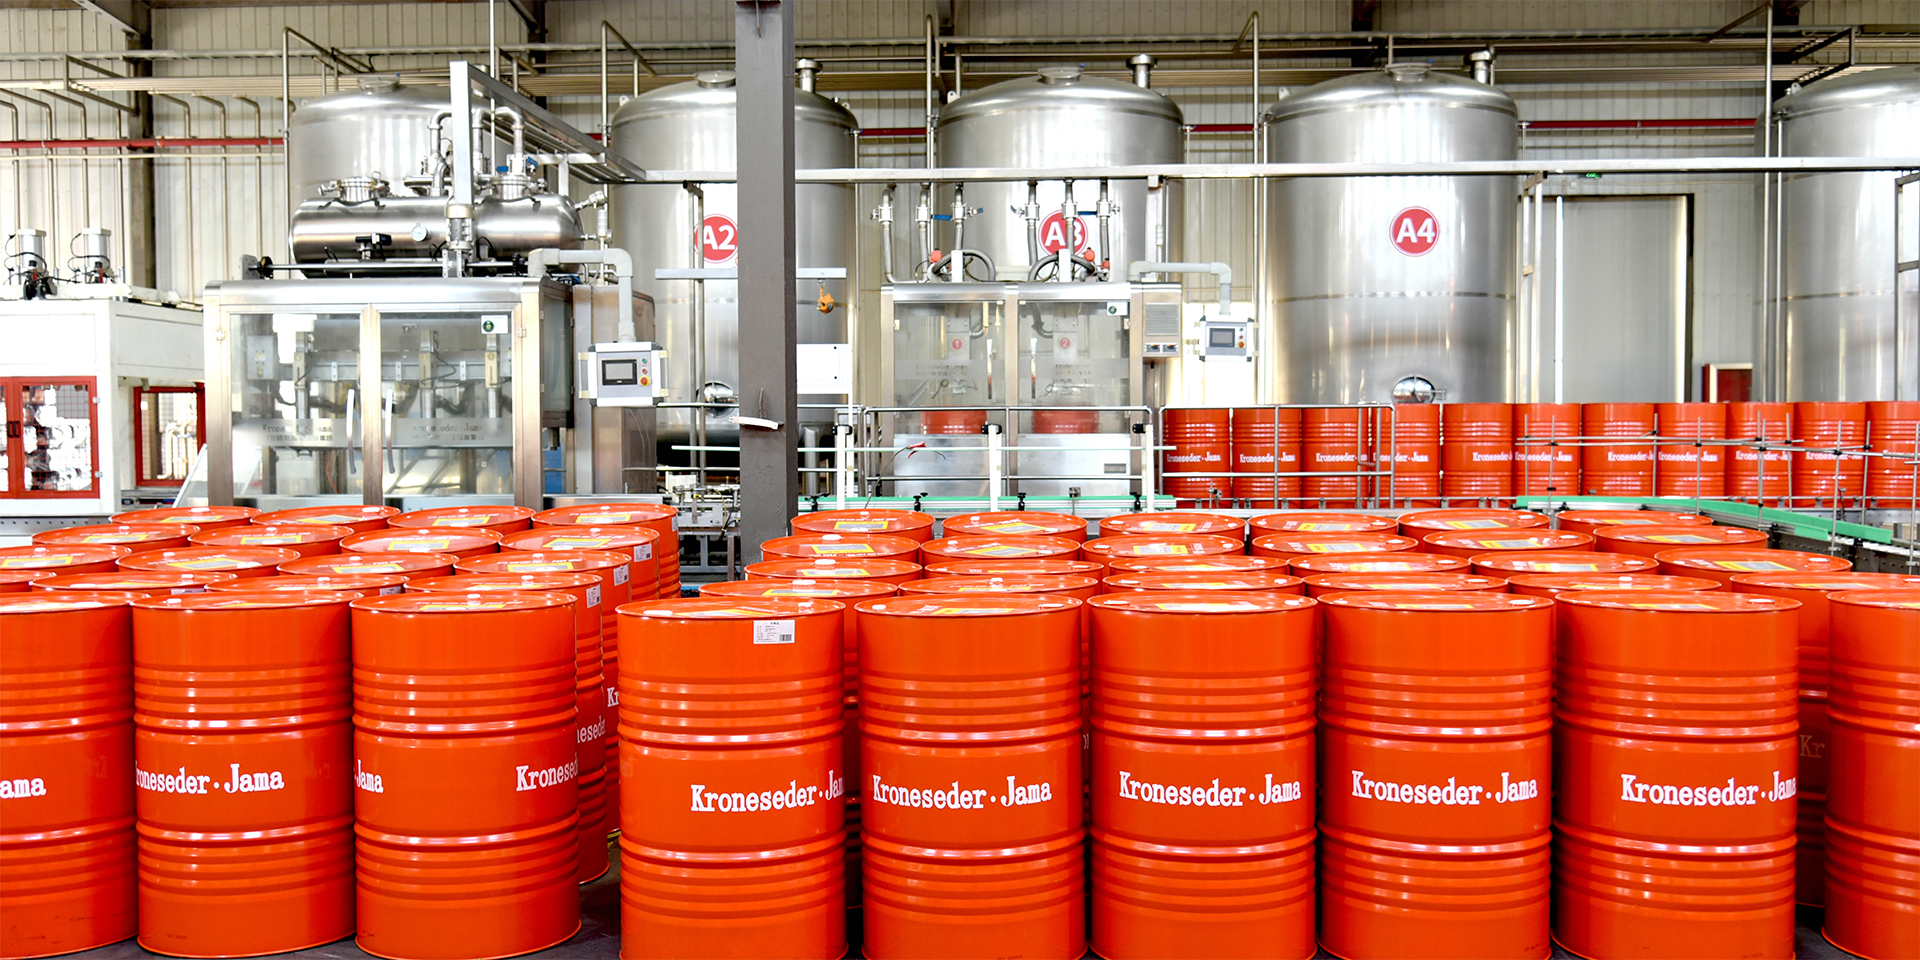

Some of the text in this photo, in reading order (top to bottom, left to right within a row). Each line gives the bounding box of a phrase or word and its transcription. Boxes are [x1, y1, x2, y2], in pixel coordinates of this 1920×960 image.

[702, 225, 736, 250] A2
[1396, 217, 1435, 243] A4
[1239, 453, 1275, 463] Kronesede
[1515, 452, 1552, 462] Kroeseder
[1735, 450, 1779, 461] Kroneder
[0, 778, 47, 799] ama
[135, 763, 285, 795] roneseder Jama
[356, 759, 384, 794] Jama
[516, 752, 579, 792] Kronesed
[1119, 770, 1302, 807] Kroneseder Jama
[1351, 770, 1538, 806] Kroneseder Jama
[1620, 770, 1797, 807] Kroneseder Jama
[690, 769, 845, 813] Kroneseder Jam
[872, 774, 1053, 810] Kroneseder Jama
